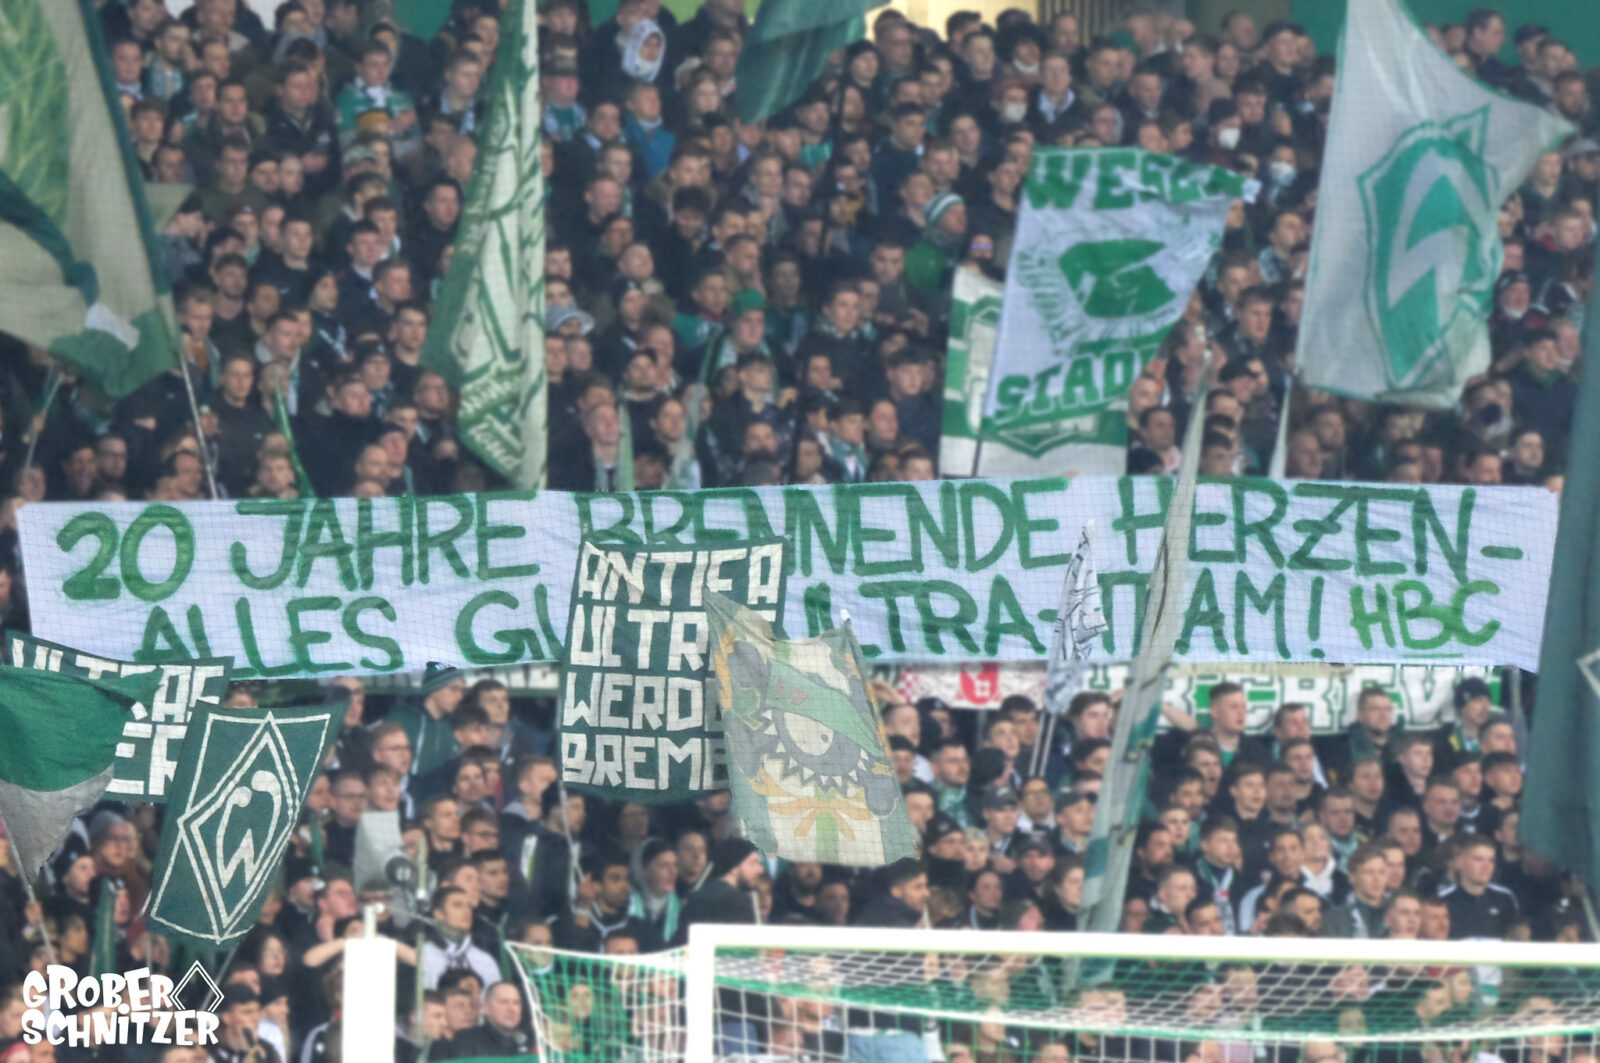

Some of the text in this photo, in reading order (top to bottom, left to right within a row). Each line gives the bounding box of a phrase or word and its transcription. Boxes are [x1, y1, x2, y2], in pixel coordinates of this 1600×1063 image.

[57, 504, 195, 601] 20
[230, 490, 541, 590] JAHRE
[578, 541, 783, 607] ANTIFA
[134, 596, 404, 678] ALLES
[1350, 580, 1501, 650] HBC
[562, 732, 732, 790] BREME
